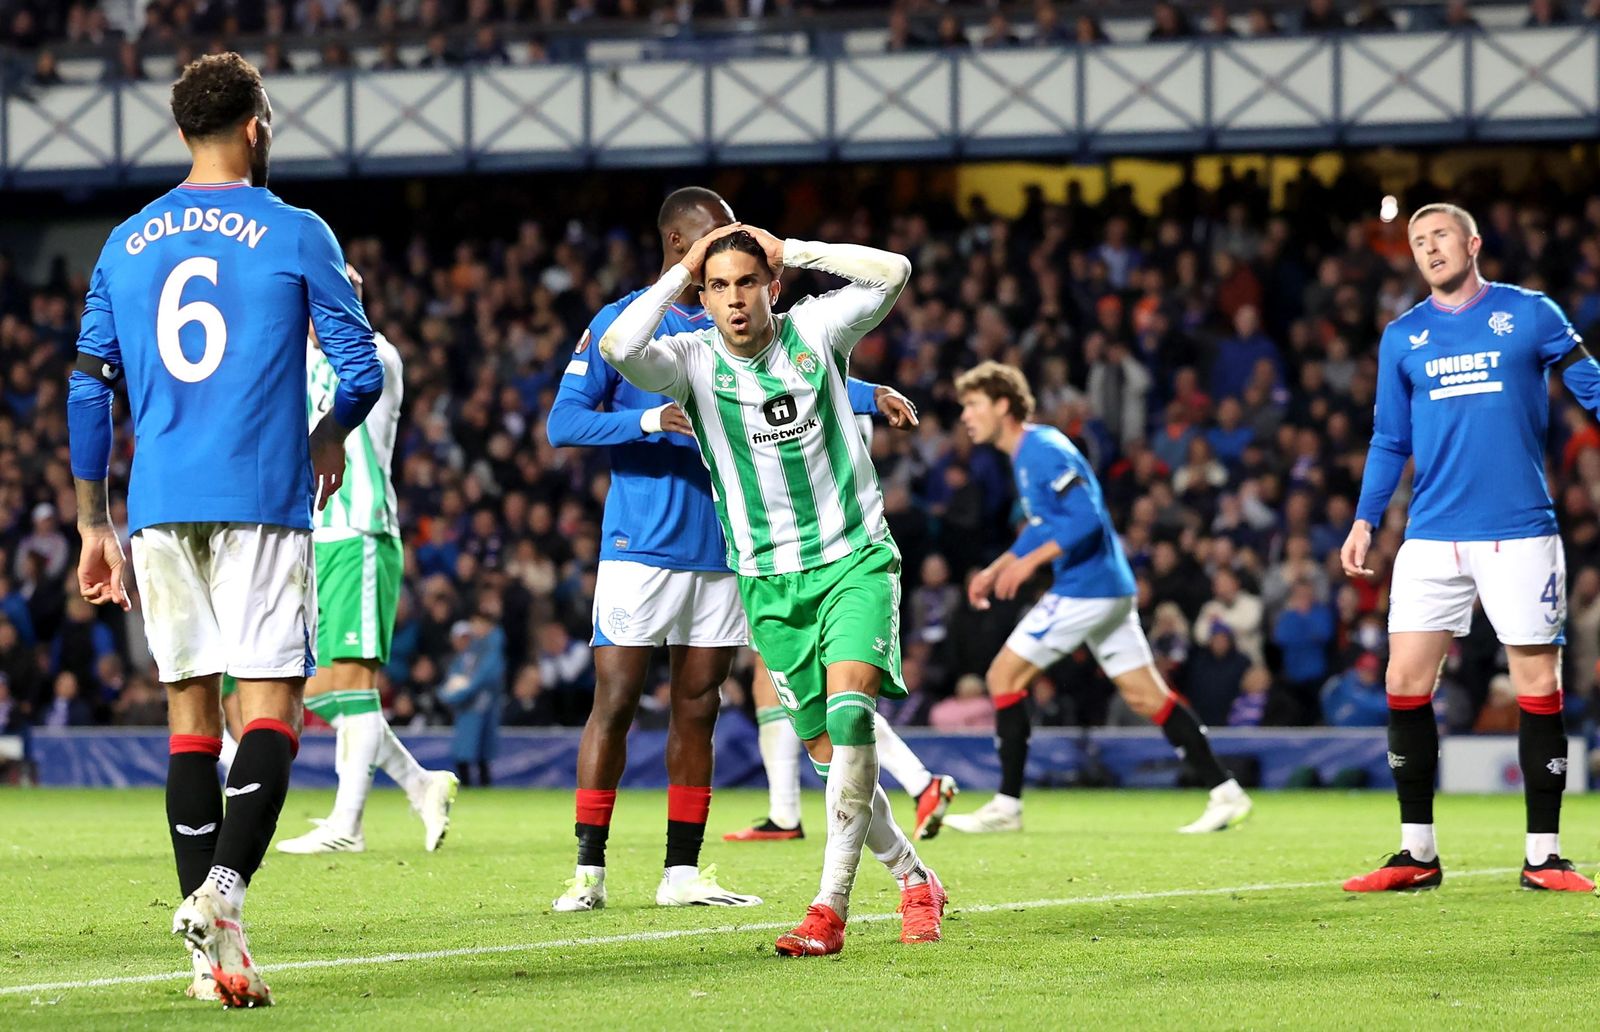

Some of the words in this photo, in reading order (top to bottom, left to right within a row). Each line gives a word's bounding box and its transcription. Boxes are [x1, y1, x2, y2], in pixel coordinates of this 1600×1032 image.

[125, 207, 267, 255] GOLDSON
[157, 256, 227, 382] 6
[1425, 351, 1501, 377] UNIBET
[752, 418, 817, 444] finetwork
[1540, 572, 1559, 610] 4
